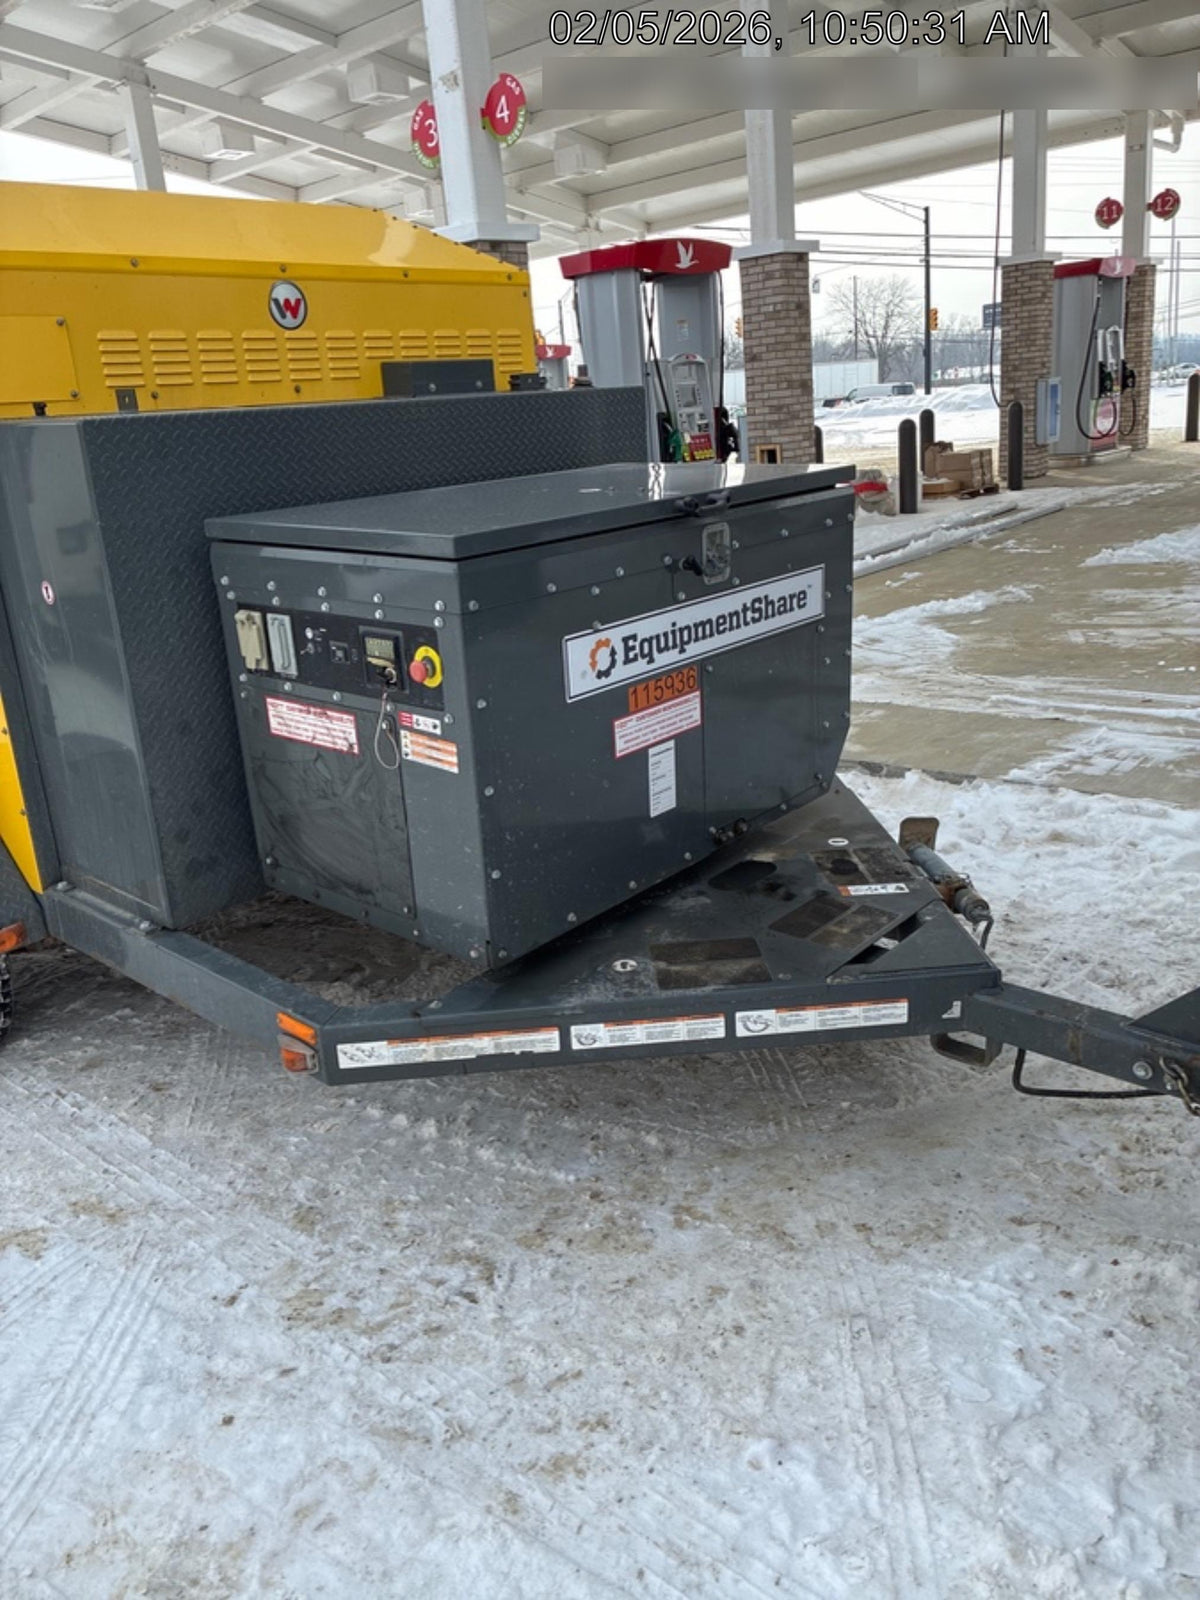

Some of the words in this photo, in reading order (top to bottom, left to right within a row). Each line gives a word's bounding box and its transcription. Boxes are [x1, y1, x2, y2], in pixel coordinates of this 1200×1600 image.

[506, 77, 520, 95] GAS
[495, 95, 510, 124] 4
[424, 118, 438, 147] 3
[506, 108, 526, 144] DIESEL
[1102, 204, 1119, 220] 11
[1155, 196, 1174, 212] 12
[622, 588, 808, 666] EquipmentShare
[630, 668, 697, 709] 115936
